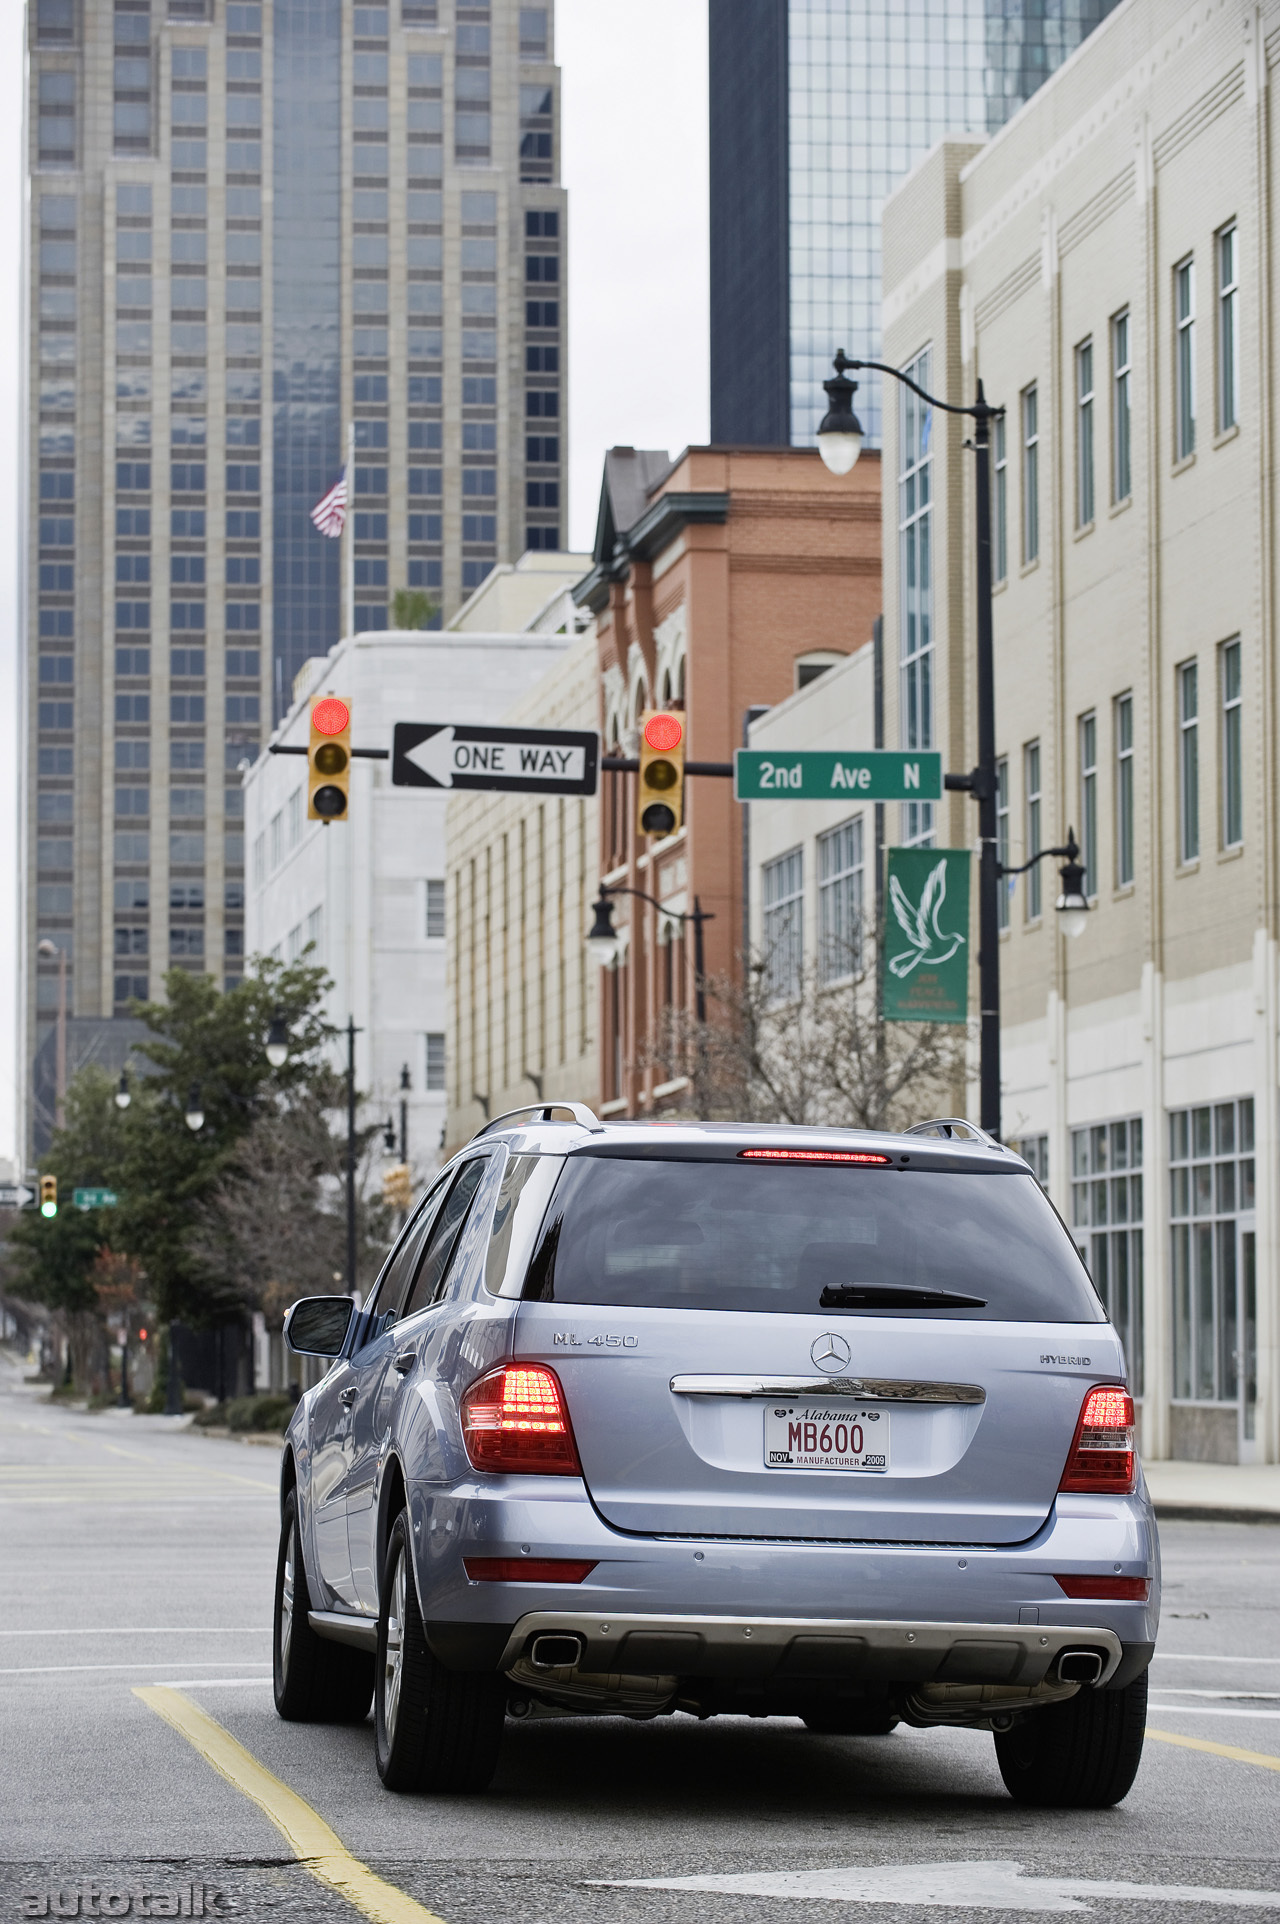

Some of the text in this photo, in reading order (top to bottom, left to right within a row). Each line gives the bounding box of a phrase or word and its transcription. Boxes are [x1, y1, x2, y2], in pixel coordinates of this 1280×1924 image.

[454, 745, 573, 774] ONE WAY
[759, 761, 920, 790] 2nd Ave N
[553, 1332, 639, 1348] ML 450
[1040, 1354, 1092, 1366] HYBRID
[796, 1408, 858, 1422] Alabama
[788, 1422, 864, 1454] MB600
[770, 1453, 788, 1462] NOV
[796, 1455, 860, 1466] MANUFACTURER
[866, 1456, 885, 1465] 2009
